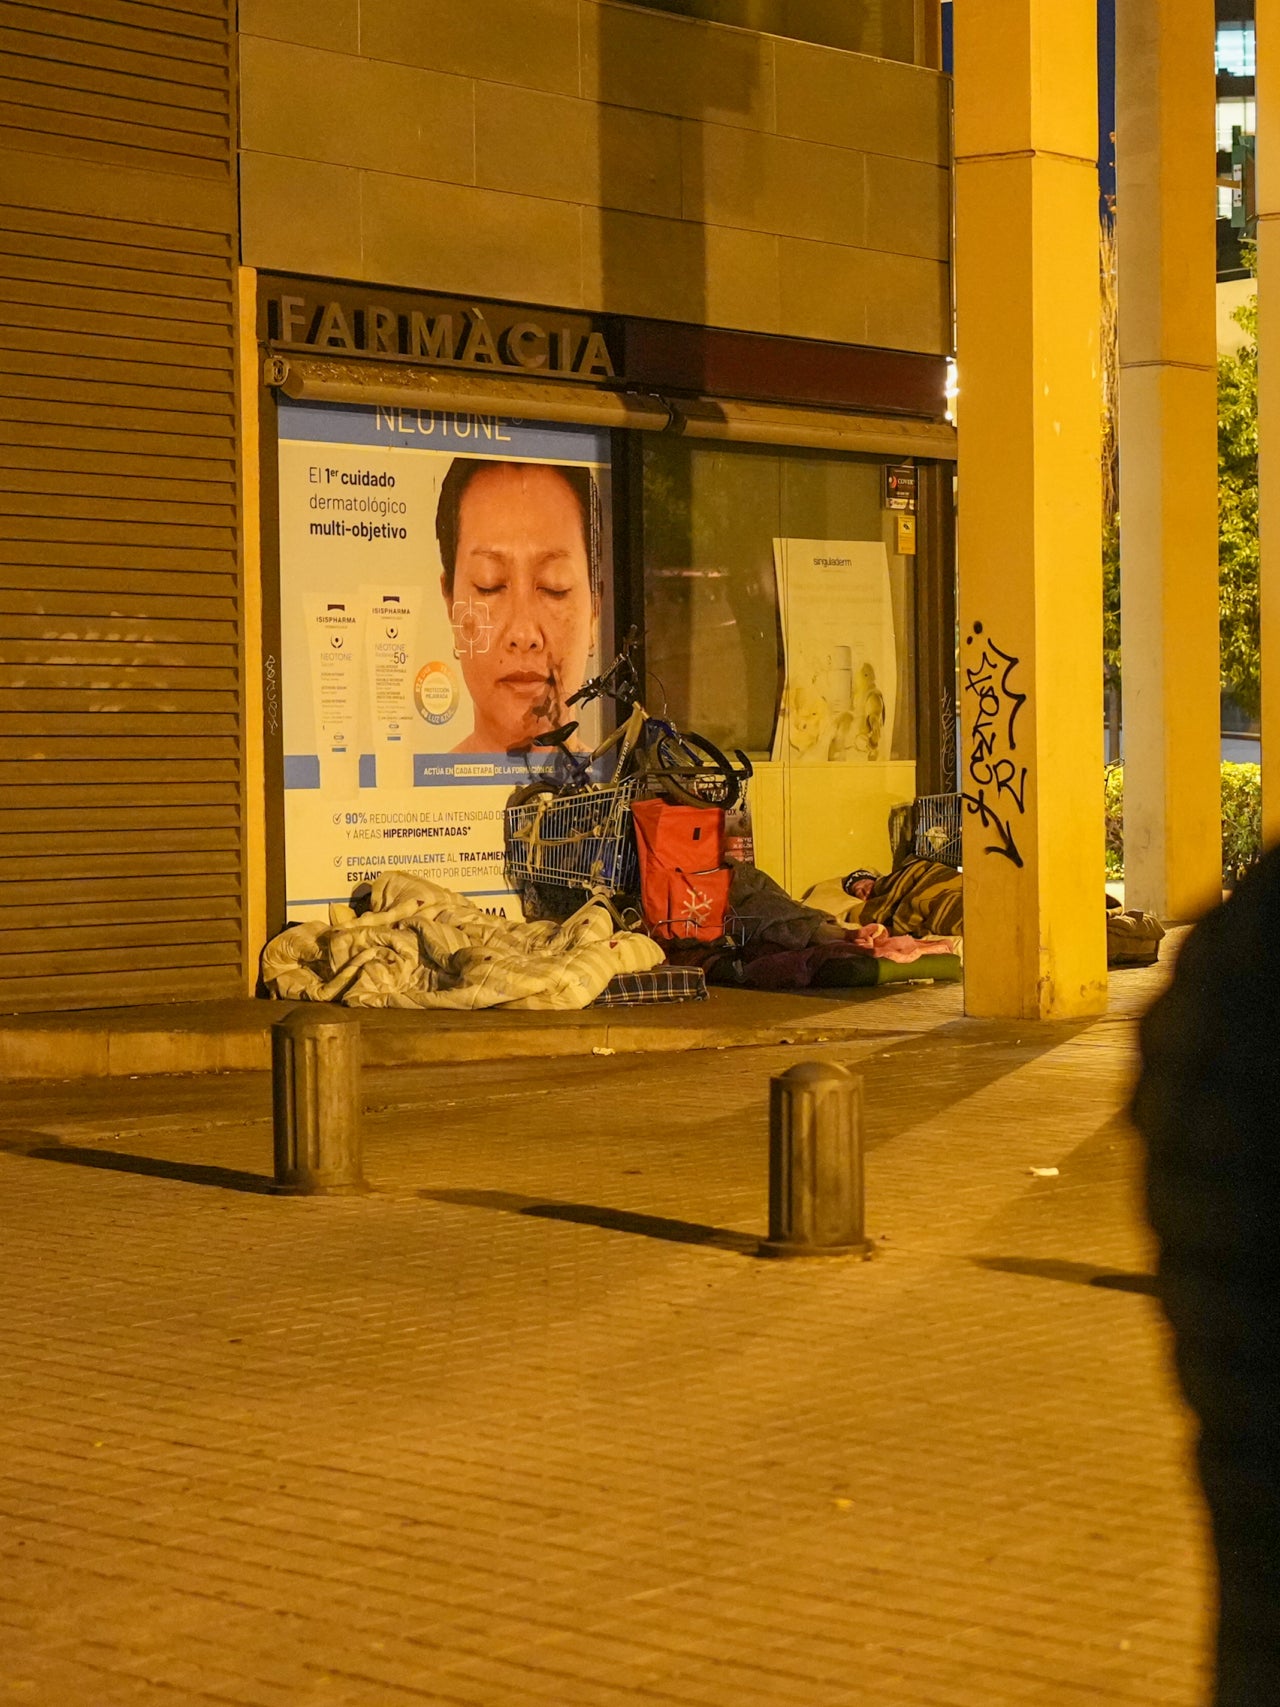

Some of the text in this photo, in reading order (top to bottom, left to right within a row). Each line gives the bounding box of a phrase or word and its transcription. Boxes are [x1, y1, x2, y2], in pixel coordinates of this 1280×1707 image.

[280, 294, 616, 377] FARMÀCIA
[309, 467, 322, 484] El
[341, 470, 396, 488] cuidado
[309, 493, 407, 517] dermatológico
[310, 520, 407, 541] multi-objetivo
[320, 652, 352, 661] NEOTONE
[424, 766, 444, 775] ACTÚA
[456, 767, 473, 775] CADA
[473, 767, 492, 775] ETAPA
[345, 812, 368, 824] 90%
[370, 811, 418, 824] REDUCCIÓN
[420, 812, 431, 823] DE
[433, 811, 444, 822] LA
[445, 810, 494, 821] INTENSIDAD
[353, 827, 382, 839] ÁREAS
[347, 855, 386, 866] EFICACIA
[388, 853, 446, 866] EQUIVALENTE
[447, 852, 457, 863] AL
[443, 867, 459, 878] POR
